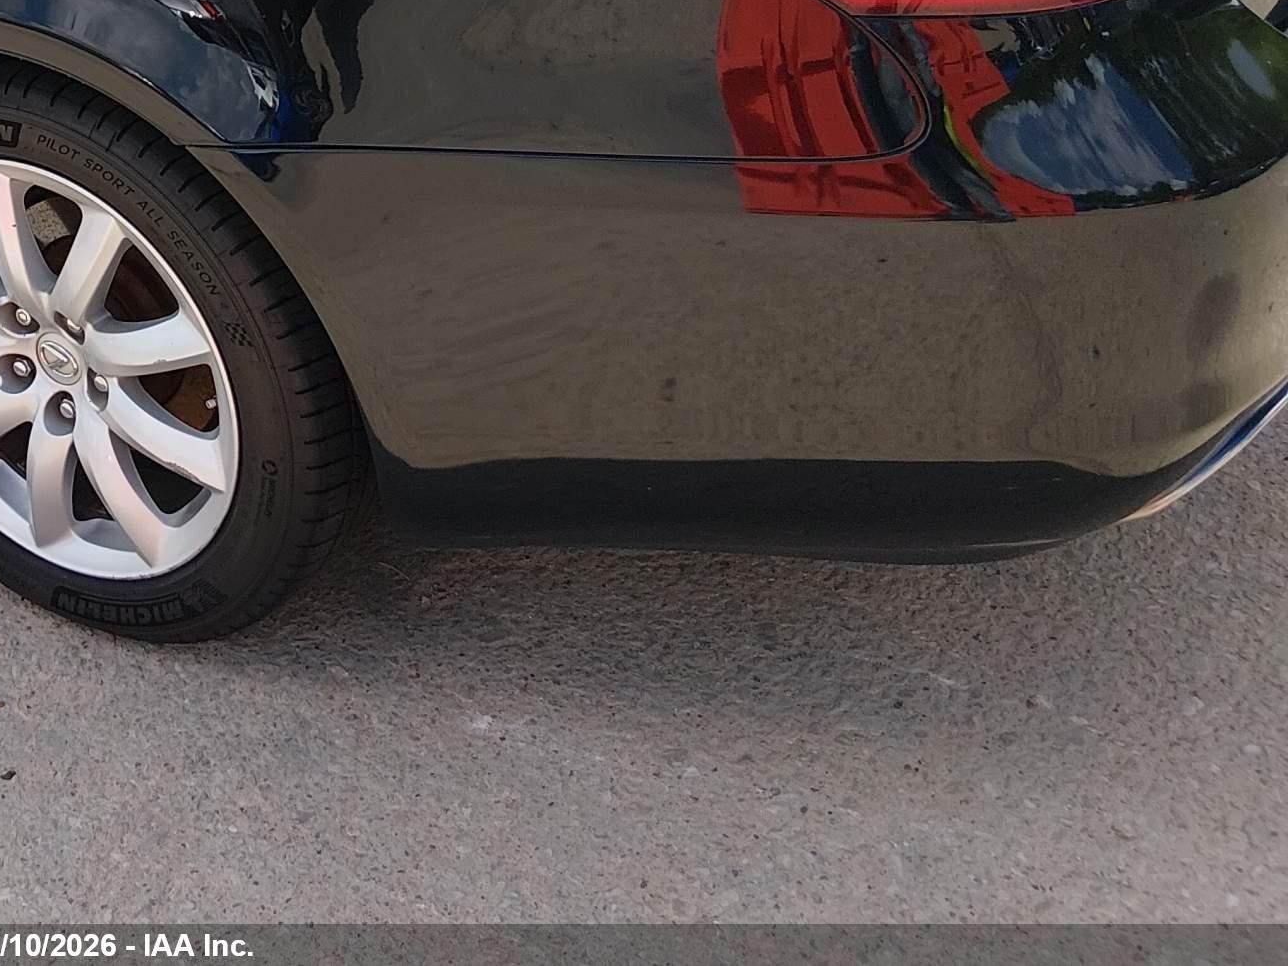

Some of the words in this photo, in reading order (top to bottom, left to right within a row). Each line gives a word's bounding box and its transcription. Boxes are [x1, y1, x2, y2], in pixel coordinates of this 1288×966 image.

[37, 134, 80, 160] PILOT
[83, 158, 135, 196] SPORT
[136, 200, 165, 227] ALL
[167, 230, 222, 296] SEASON
[57, 593, 185, 624] MICHELIN
